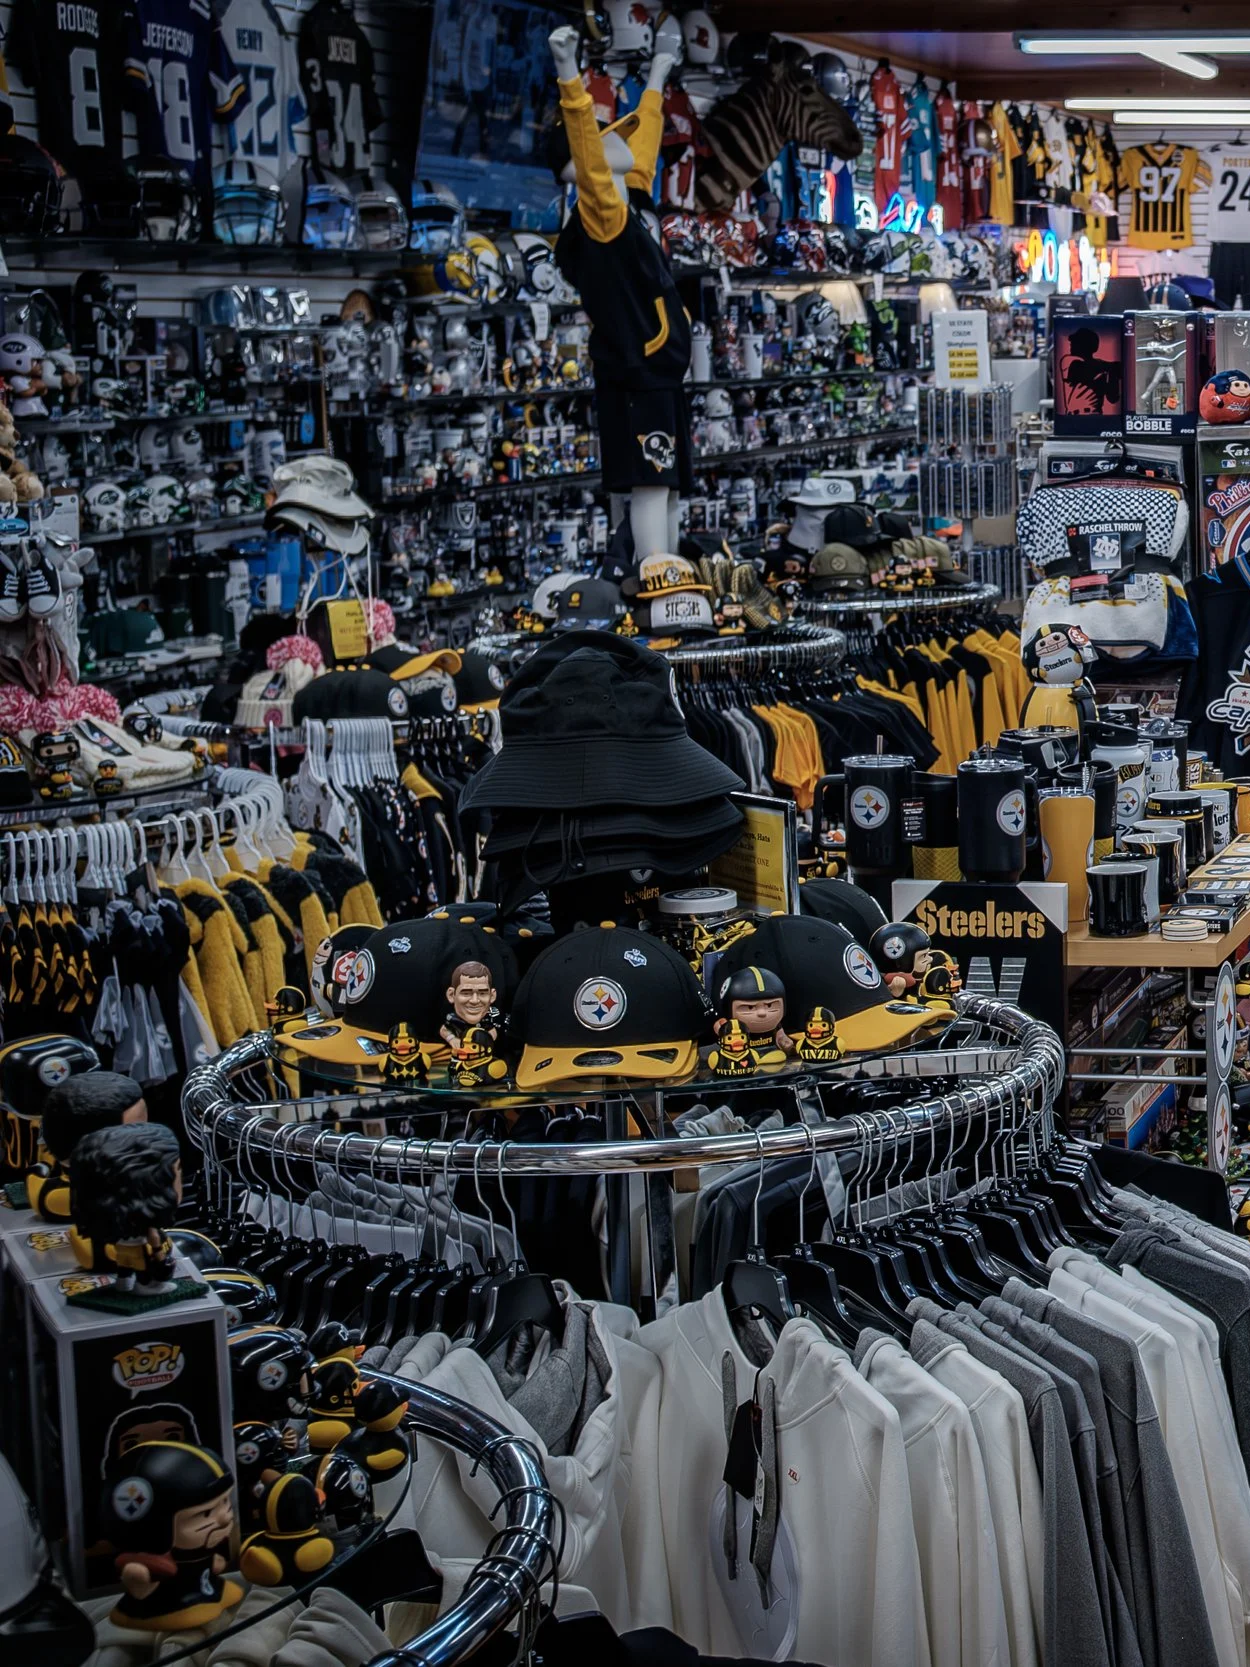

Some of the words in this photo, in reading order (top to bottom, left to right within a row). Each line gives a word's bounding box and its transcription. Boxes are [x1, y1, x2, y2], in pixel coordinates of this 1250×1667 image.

[142, 22, 195, 59] JEFFERSON
[68, 46, 106, 148] 8
[146, 57, 197, 162] 18
[325, 78, 371, 171] 34
[1138, 166, 1182, 204] 97
[1126, 420, 1172, 432] BOBBLE
[1079, 522, 1115, 535] RASCHEL
[1114, 522, 1144, 533] THROW
[1043, 657, 1073, 672] Steelers
[915, 900, 1047, 939] Steelers
[749, 1036, 773, 1047] teelers
[989, 1195, 998, 1203] XL
[114, 1343, 182, 1379] POP!
[126, 1372, 175, 1388] FOOTBALL
[787, 1468, 799, 1483] XXL
